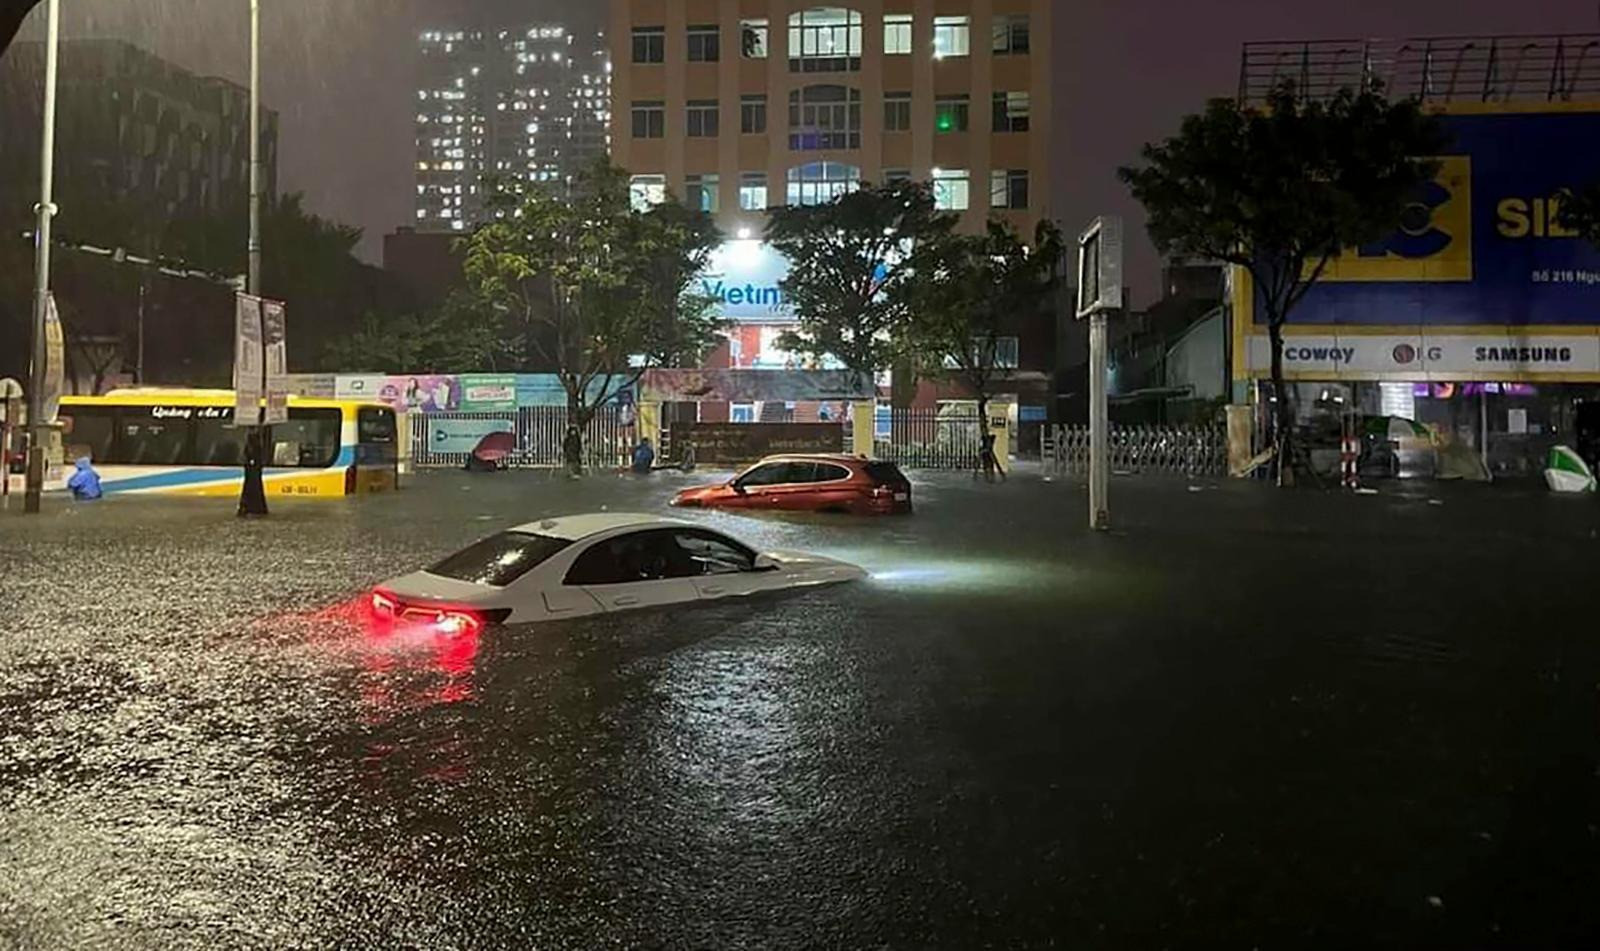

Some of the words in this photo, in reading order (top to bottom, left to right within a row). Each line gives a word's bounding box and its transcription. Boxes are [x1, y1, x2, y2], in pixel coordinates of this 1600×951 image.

[702, 280, 783, 305] Vietin
[1285, 347, 1355, 364] coway
[1475, 346, 1572, 362] SAMSUNG
